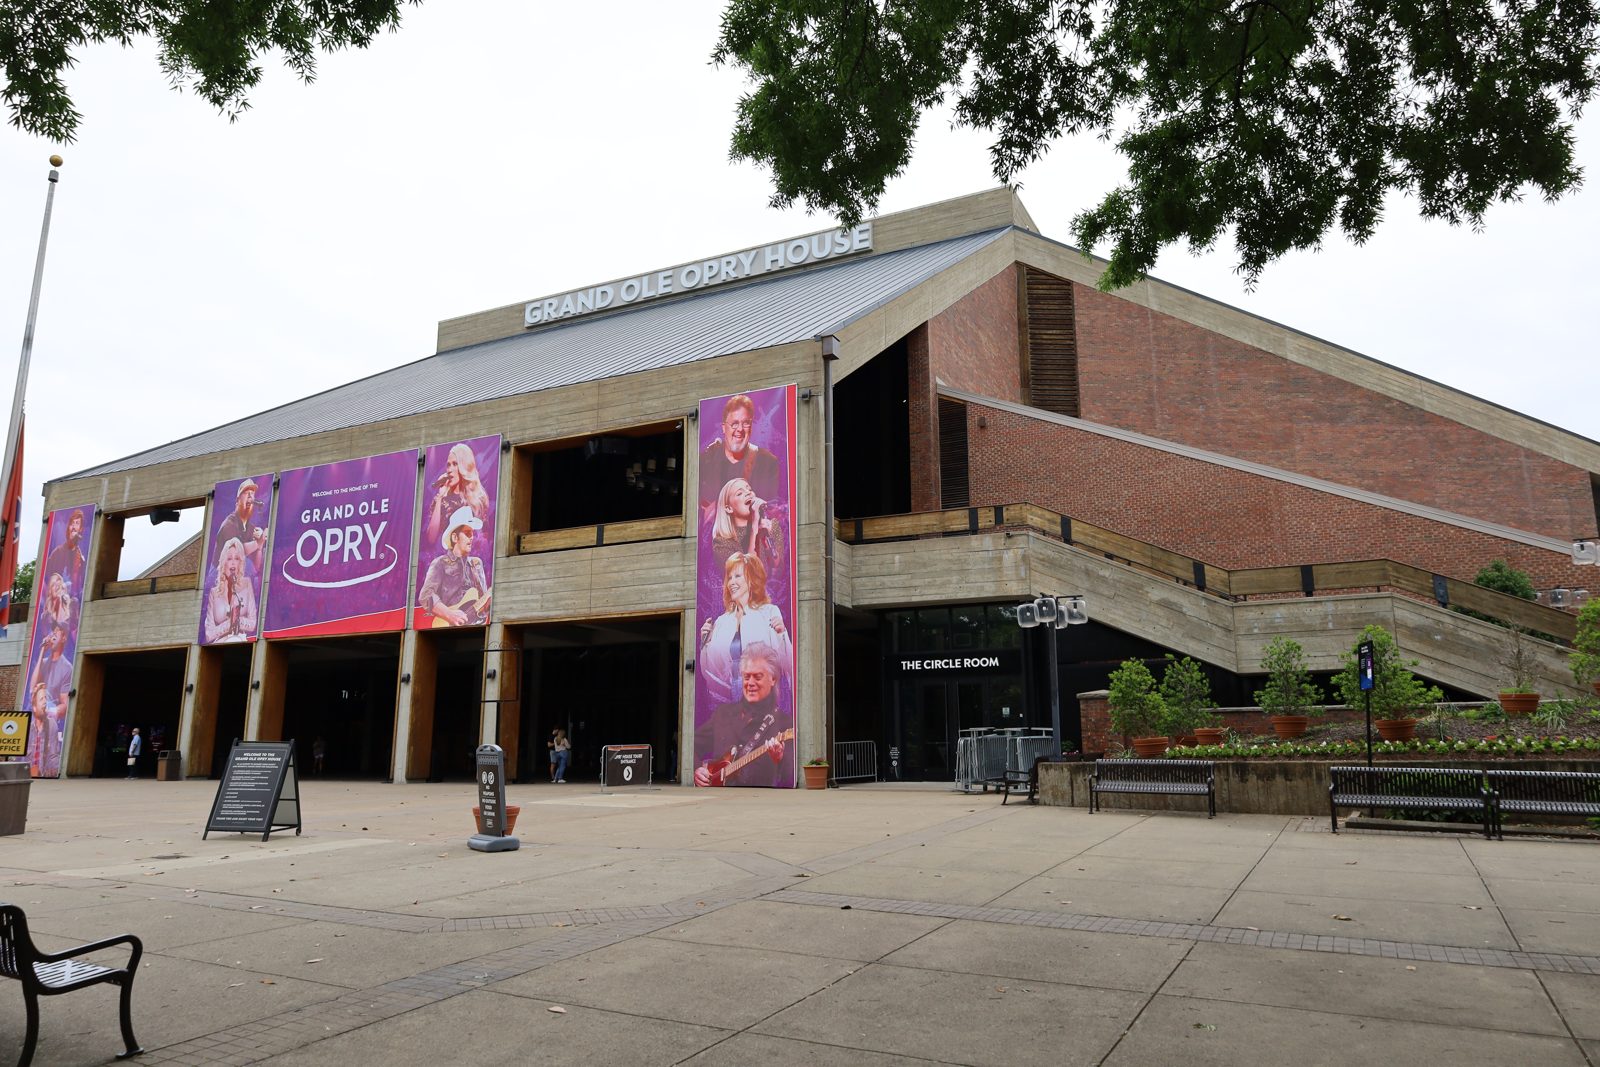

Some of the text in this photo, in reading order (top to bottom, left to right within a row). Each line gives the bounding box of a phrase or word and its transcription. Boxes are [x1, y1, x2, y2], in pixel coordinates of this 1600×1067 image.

[524, 223, 872, 325] GRAND OLE OPRY HOUSE
[301, 498, 390, 524] GRAND OLE
[296, 521, 388, 568] OPRY
[901, 657, 999, 670] THE CIRCLE ROOM
